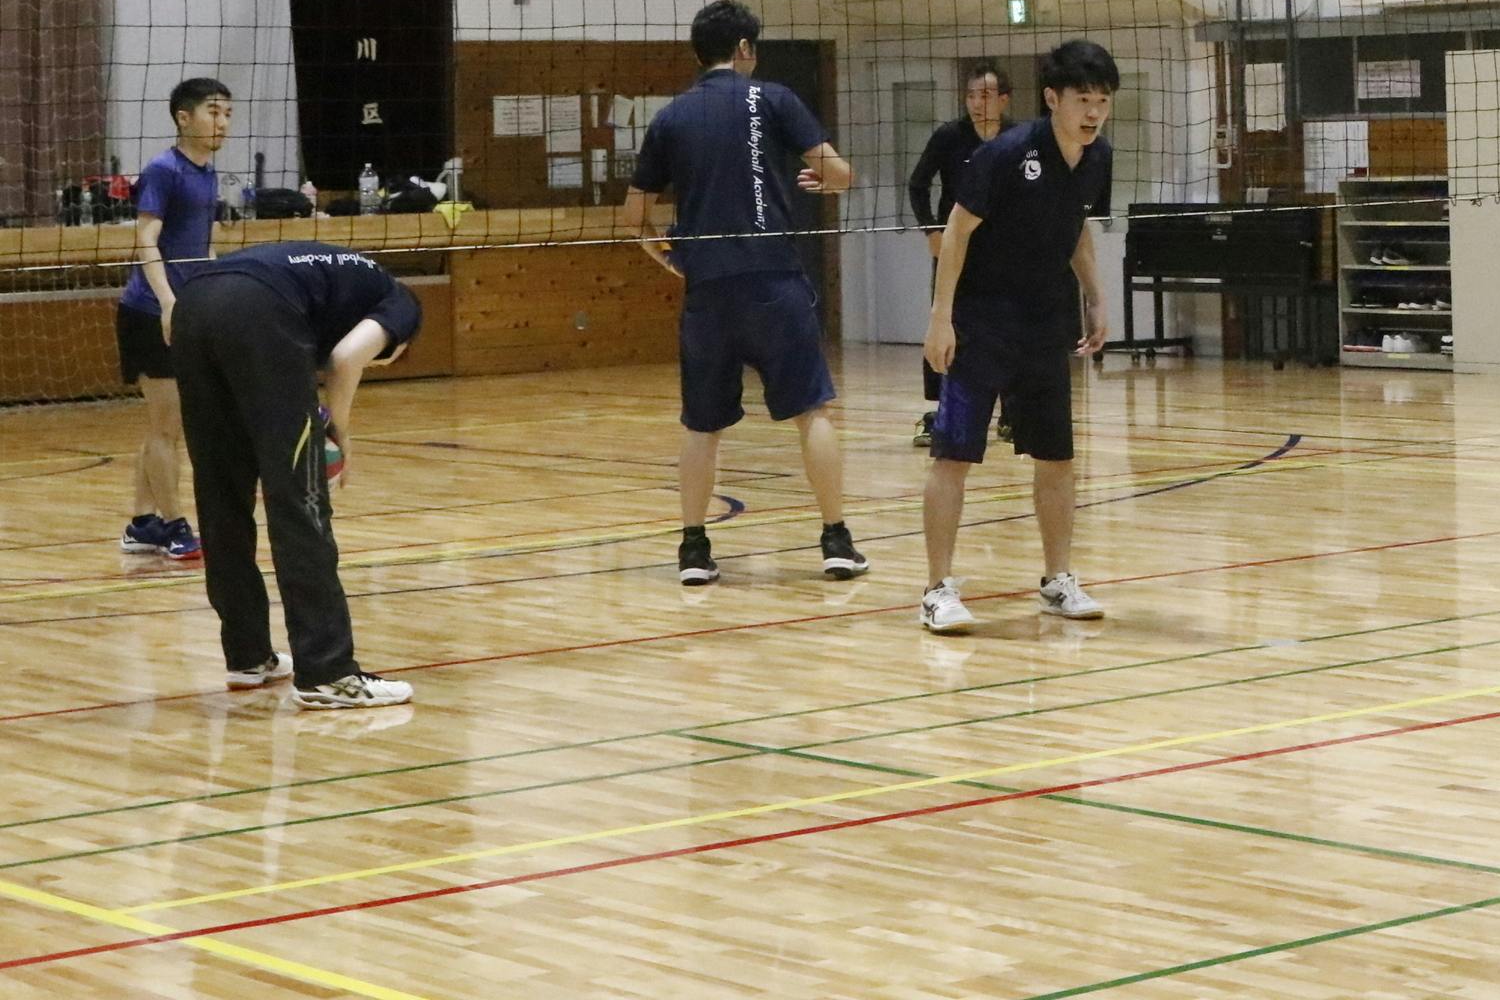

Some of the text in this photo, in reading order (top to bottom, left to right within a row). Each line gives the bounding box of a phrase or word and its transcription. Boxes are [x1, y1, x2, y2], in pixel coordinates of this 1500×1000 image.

[745, 85, 768, 231] Tokyo Volleyball Academy
[287, 253, 333, 266] Academy
